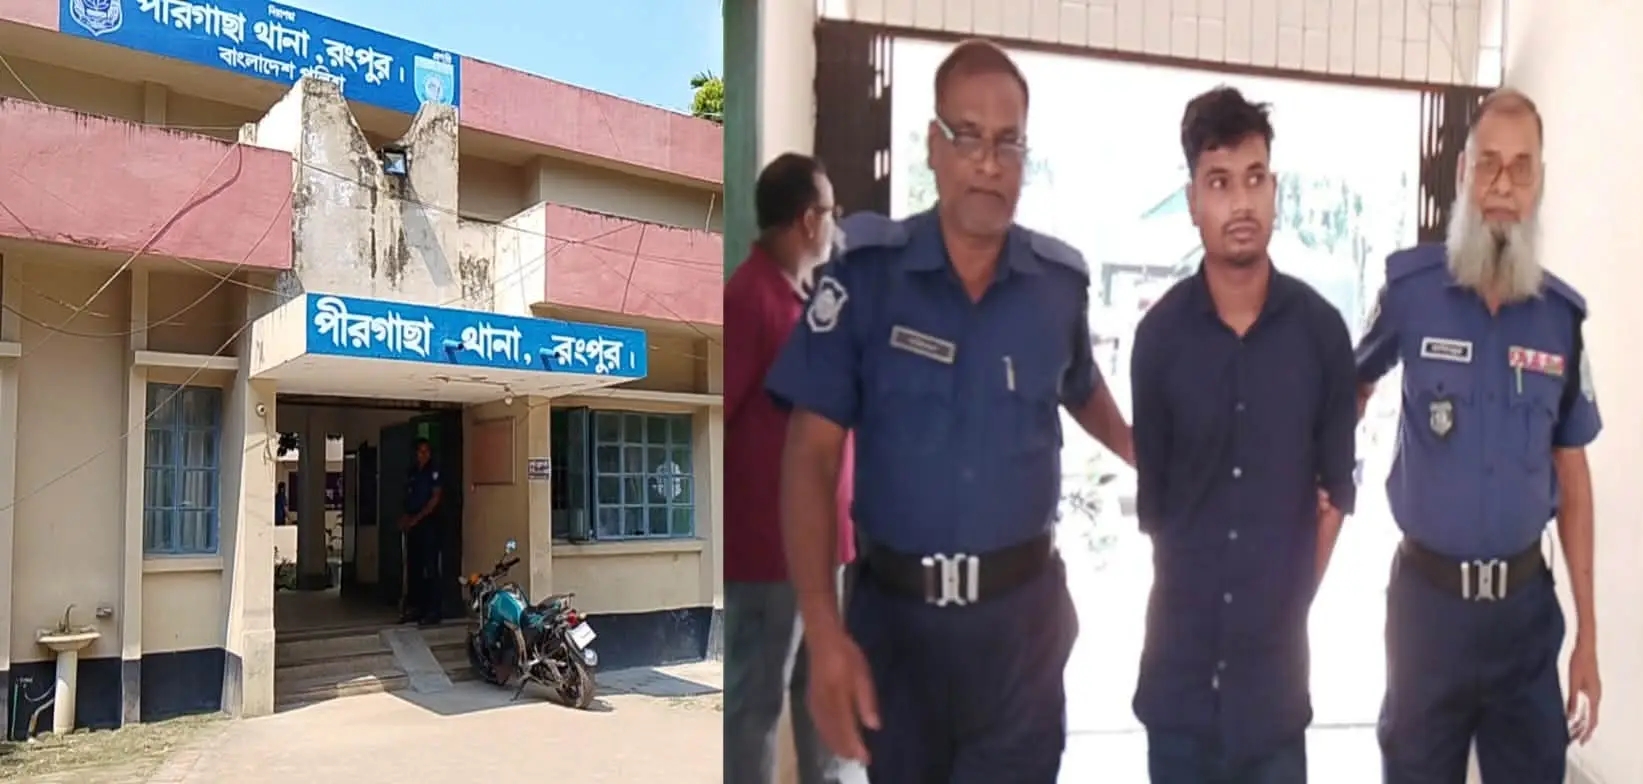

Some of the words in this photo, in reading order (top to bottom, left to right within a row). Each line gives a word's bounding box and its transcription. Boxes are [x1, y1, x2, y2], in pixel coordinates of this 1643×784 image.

[217, 46, 297, 80] বাংলাদেশ
[314, 296, 435, 358] পীরগাছা
[461, 320, 532, 366] থানা,
